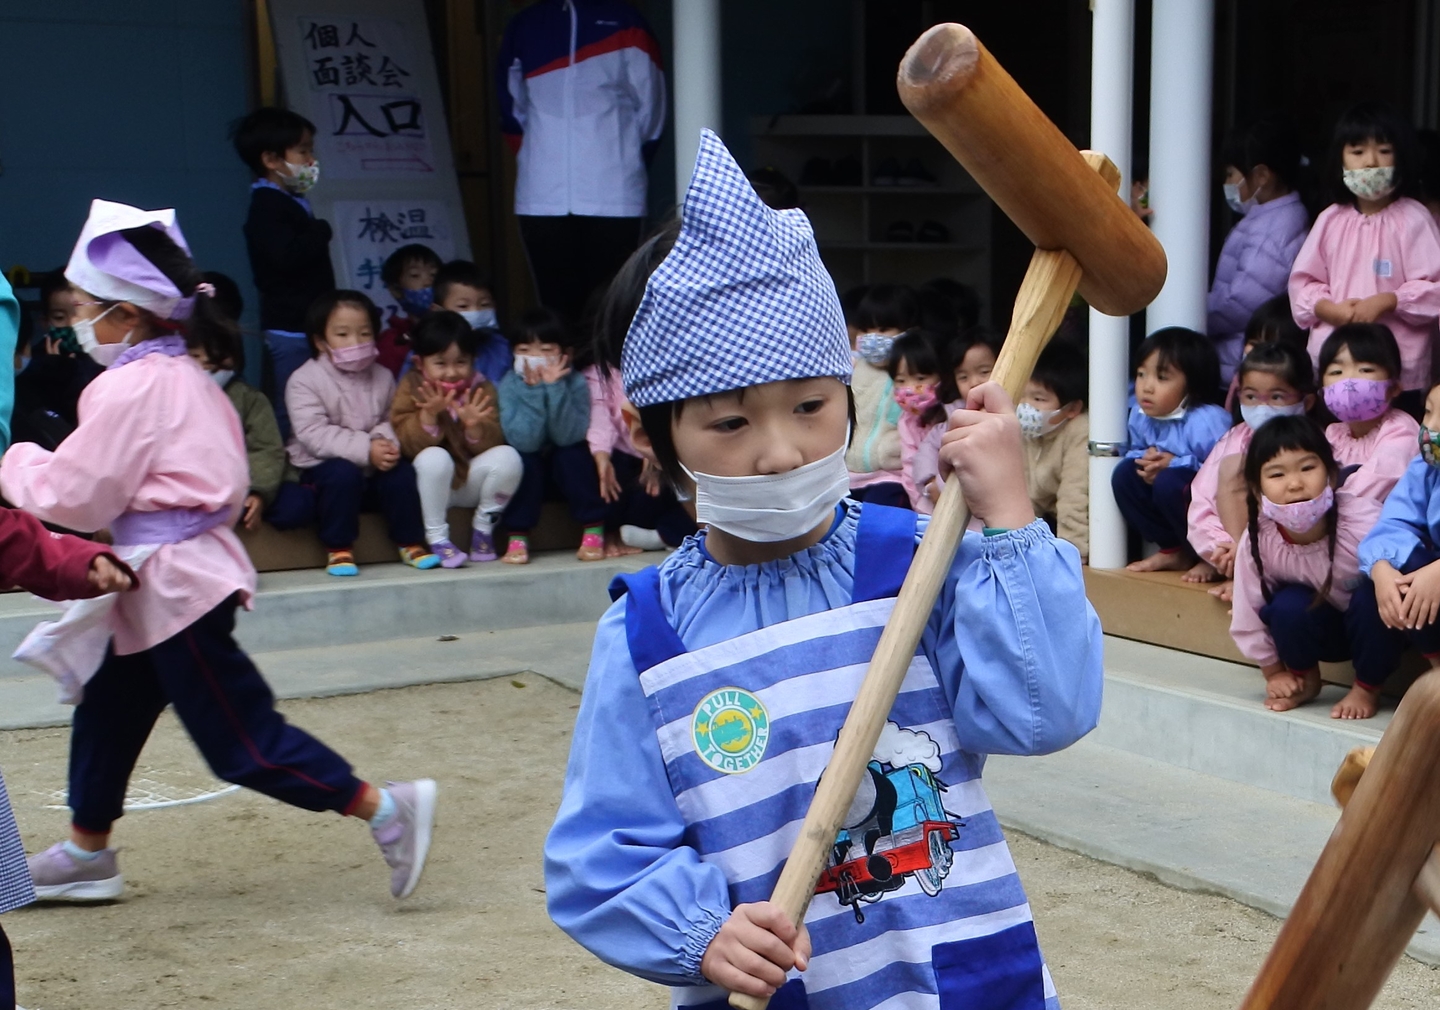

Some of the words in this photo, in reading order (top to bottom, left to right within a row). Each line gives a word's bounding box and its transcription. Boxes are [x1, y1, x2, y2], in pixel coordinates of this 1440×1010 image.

[303, 22, 376, 50] 個人
[313, 53, 410, 88] 面談会
[333, 95, 421, 137] 入口
[358, 207, 434, 243] 検温
[702, 692, 741, 717] PULL
[702, 728, 768, 771] TOGETHER
